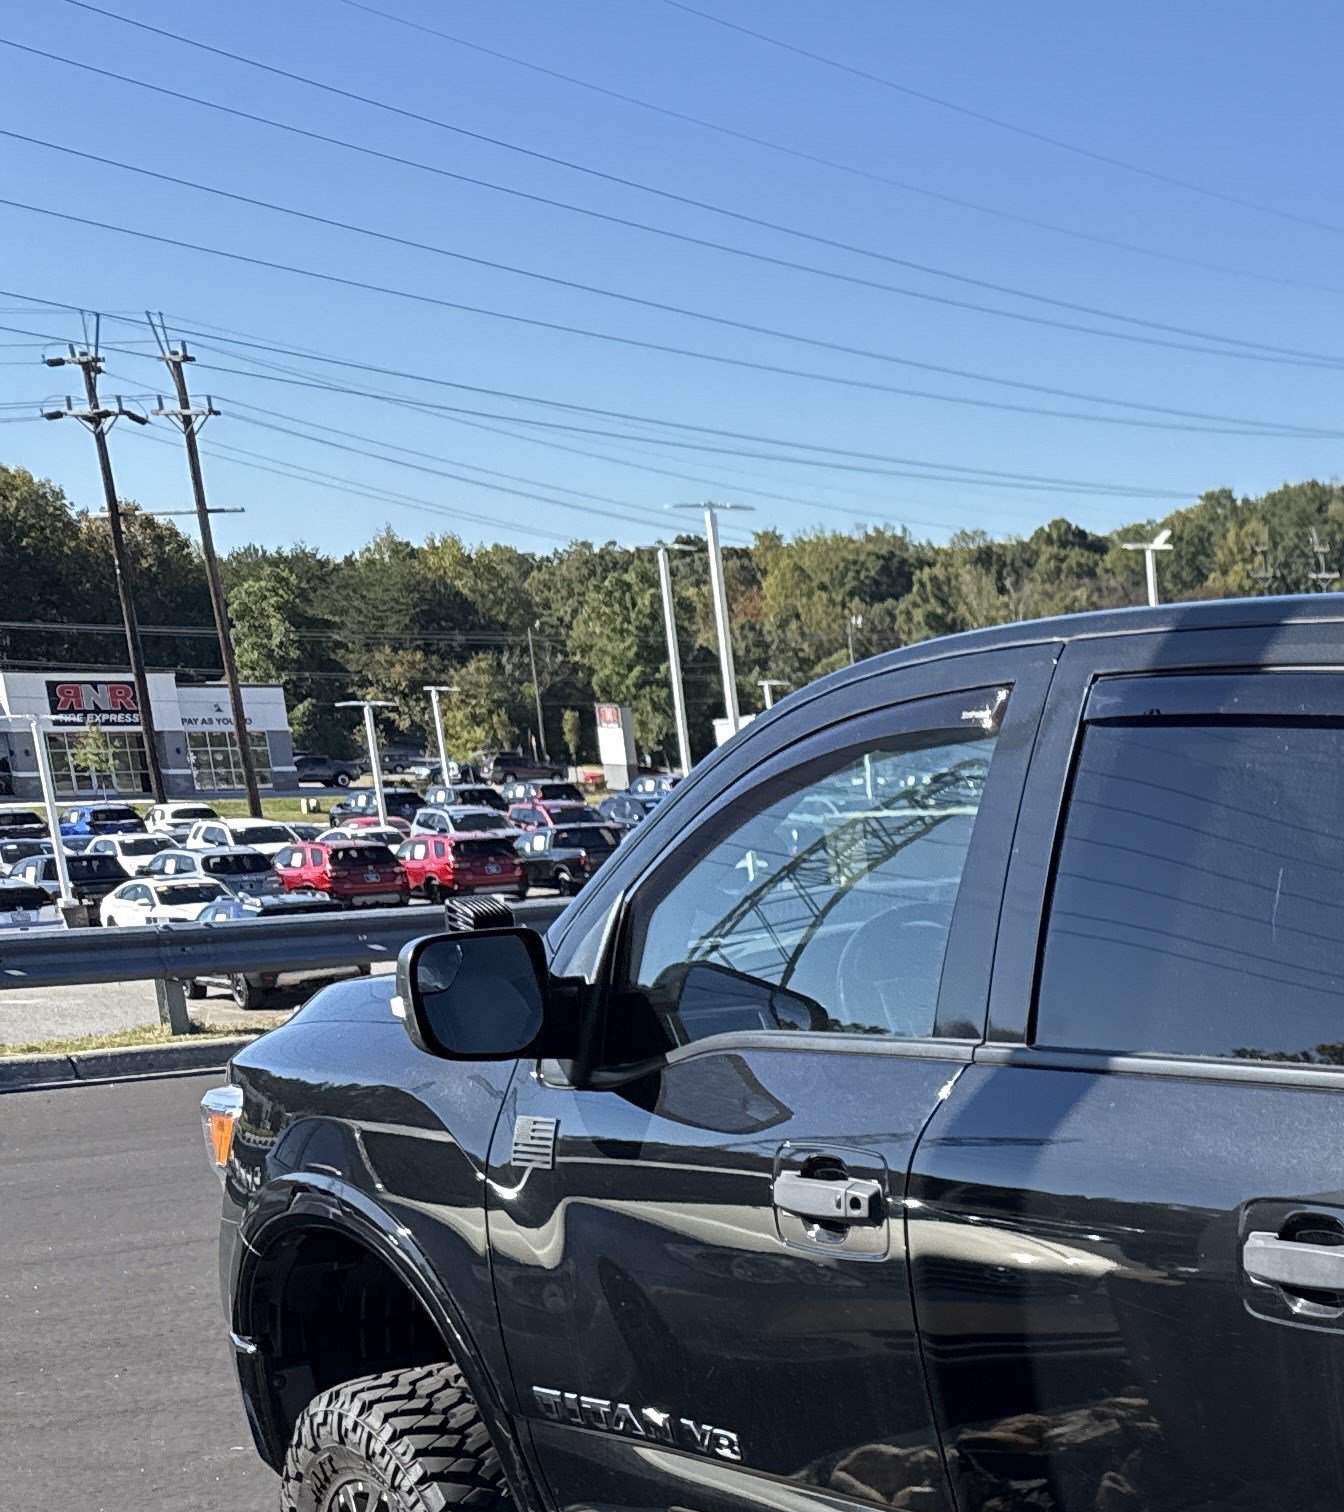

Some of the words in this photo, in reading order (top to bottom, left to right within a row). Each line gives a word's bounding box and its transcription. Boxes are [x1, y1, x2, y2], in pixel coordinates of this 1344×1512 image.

[86, 712, 140, 723] EXPRESS
[181, 717, 199, 726] PAY
[201, 717, 214, 726] AS
[531, 1385, 675, 1444] TITAN
[679, 1417, 744, 1462] V8
